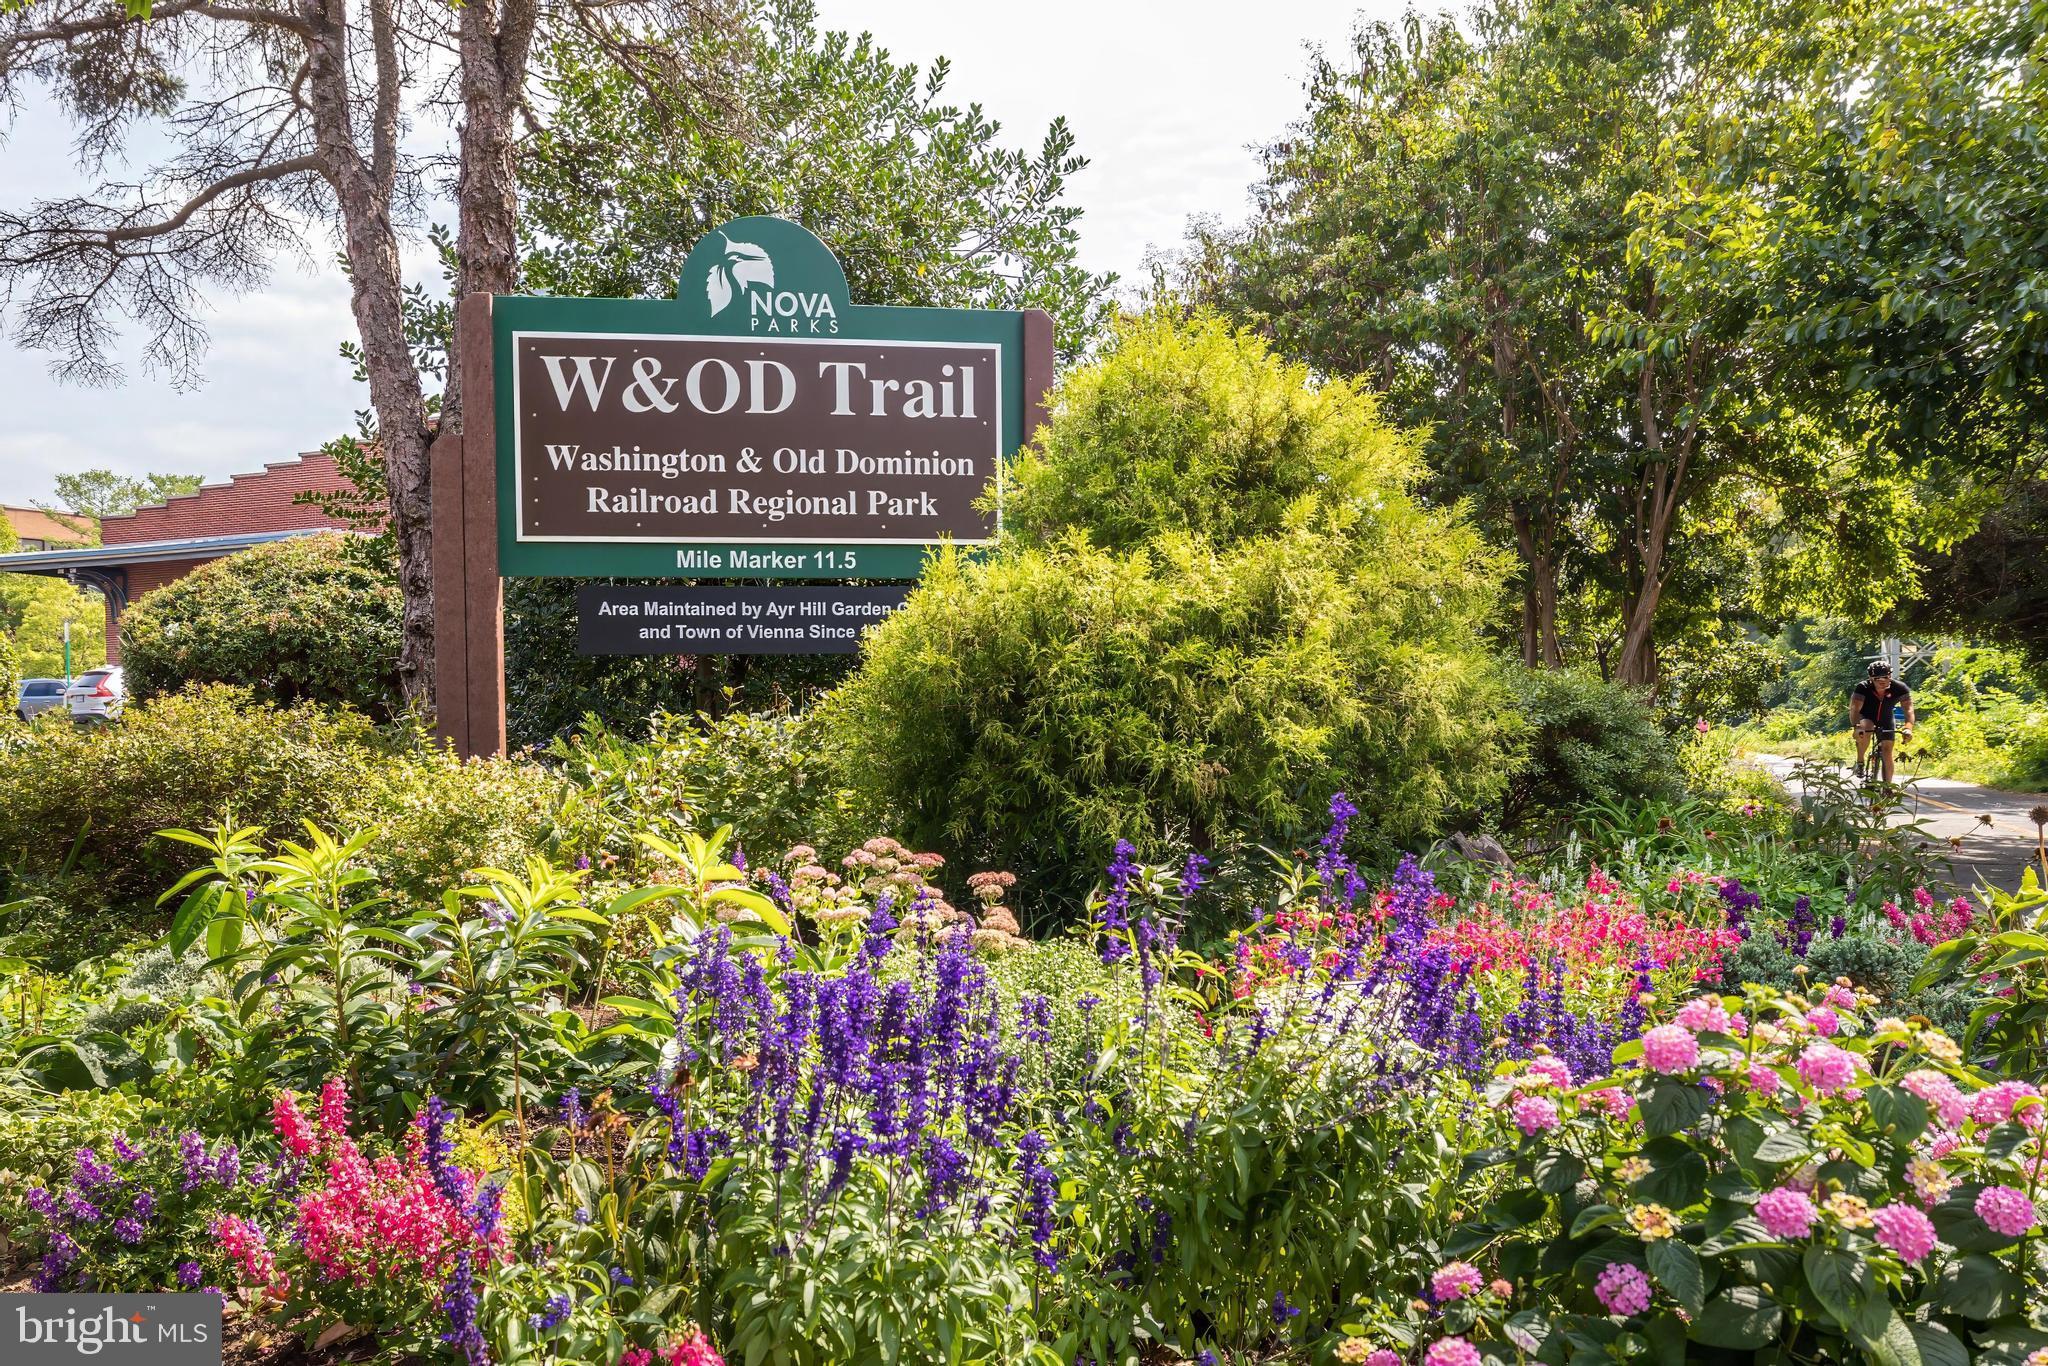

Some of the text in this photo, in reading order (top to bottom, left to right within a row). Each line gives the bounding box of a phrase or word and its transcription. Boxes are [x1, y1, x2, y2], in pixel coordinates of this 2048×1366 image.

[750, 290, 837, 318] NOVA
[752, 318, 838, 333] PARKS
[540, 355, 978, 418] W&OD Trail
[545, 445, 974, 478] Washington & Old Dominion
[587, 487, 938, 519] Railroad Regional Park
[677, 550, 856, 569] Mile Marker 11.5
[599, 602, 638, 615] Area
[645, 602, 736, 615] Maintained
[742, 602, 762, 619] by
[766, 602, 795, 619] Ayr
[800, 602, 826, 615] Hill
[831, 602, 891, 616] Garden
[640, 625, 670, 638] and
[676, 625, 720, 638] Town
[726, 625, 743, 638] of
[747, 625, 804, 638] Vienna
[809, 625, 855, 638] Since
